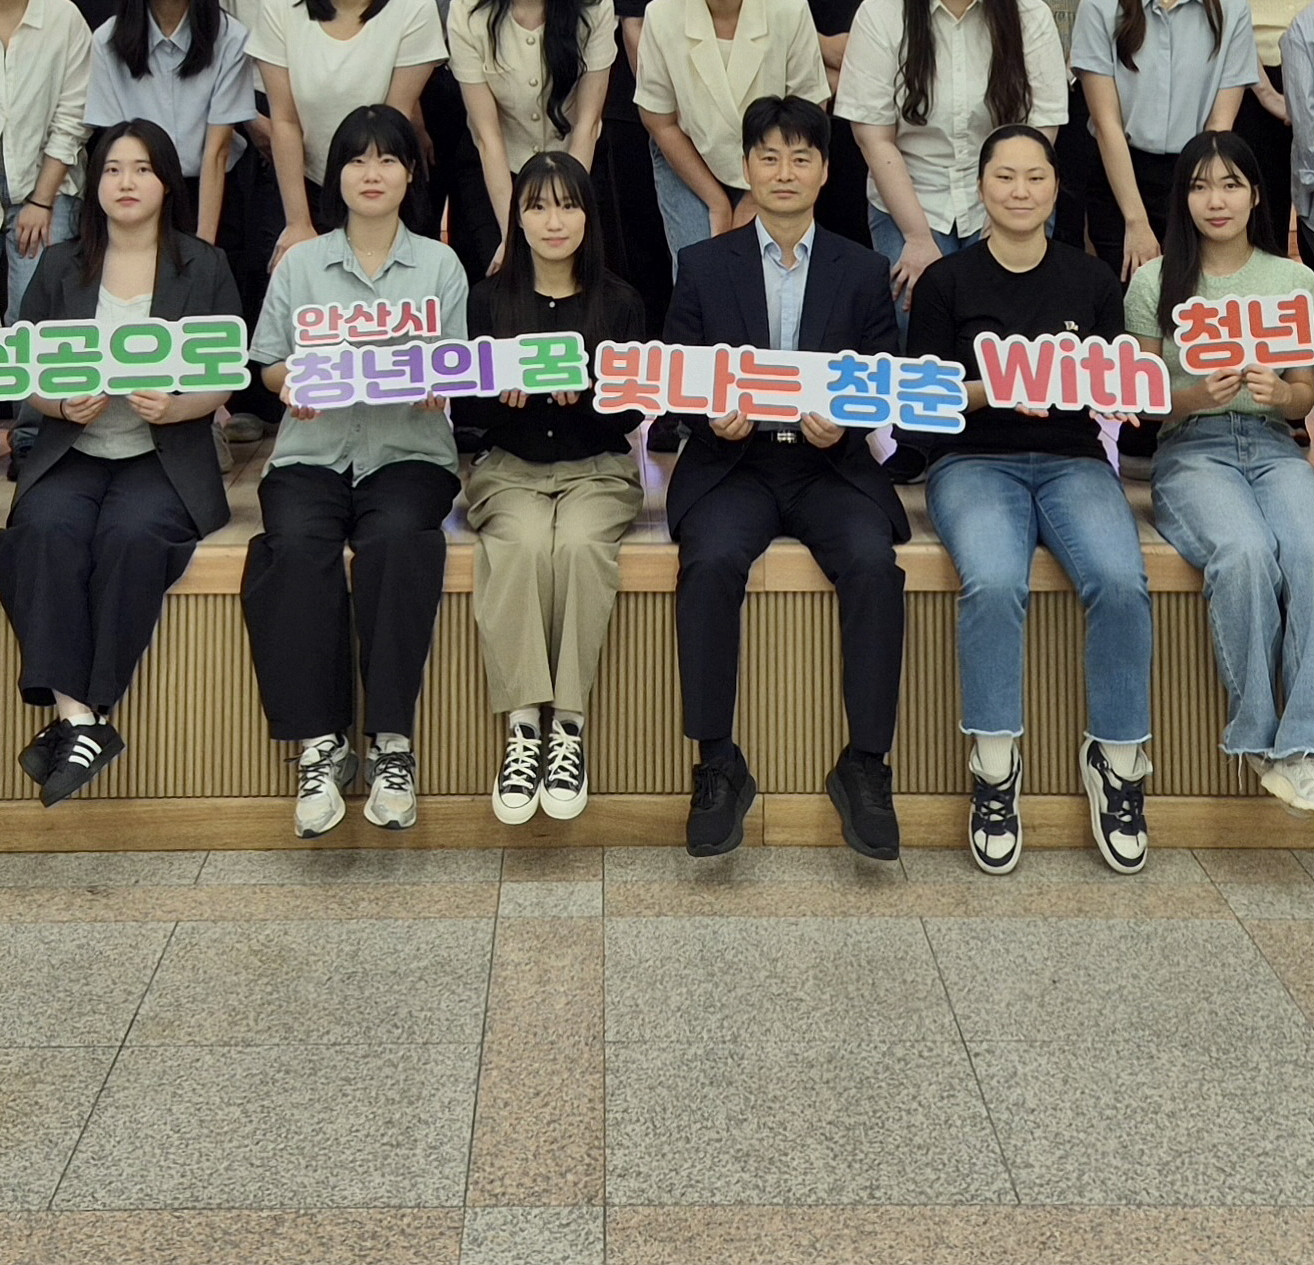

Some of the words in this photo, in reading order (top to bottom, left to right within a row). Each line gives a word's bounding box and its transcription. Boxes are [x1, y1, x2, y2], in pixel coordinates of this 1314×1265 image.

[296, 299, 438, 343] 안산시
[292, 339, 496, 405] 청년의
[518, 337, 585, 388] 꿈
[597, 345, 802, 417] 빛나는
[826, 354, 963, 429] 청춘
[979, 334, 1168, 410] With
